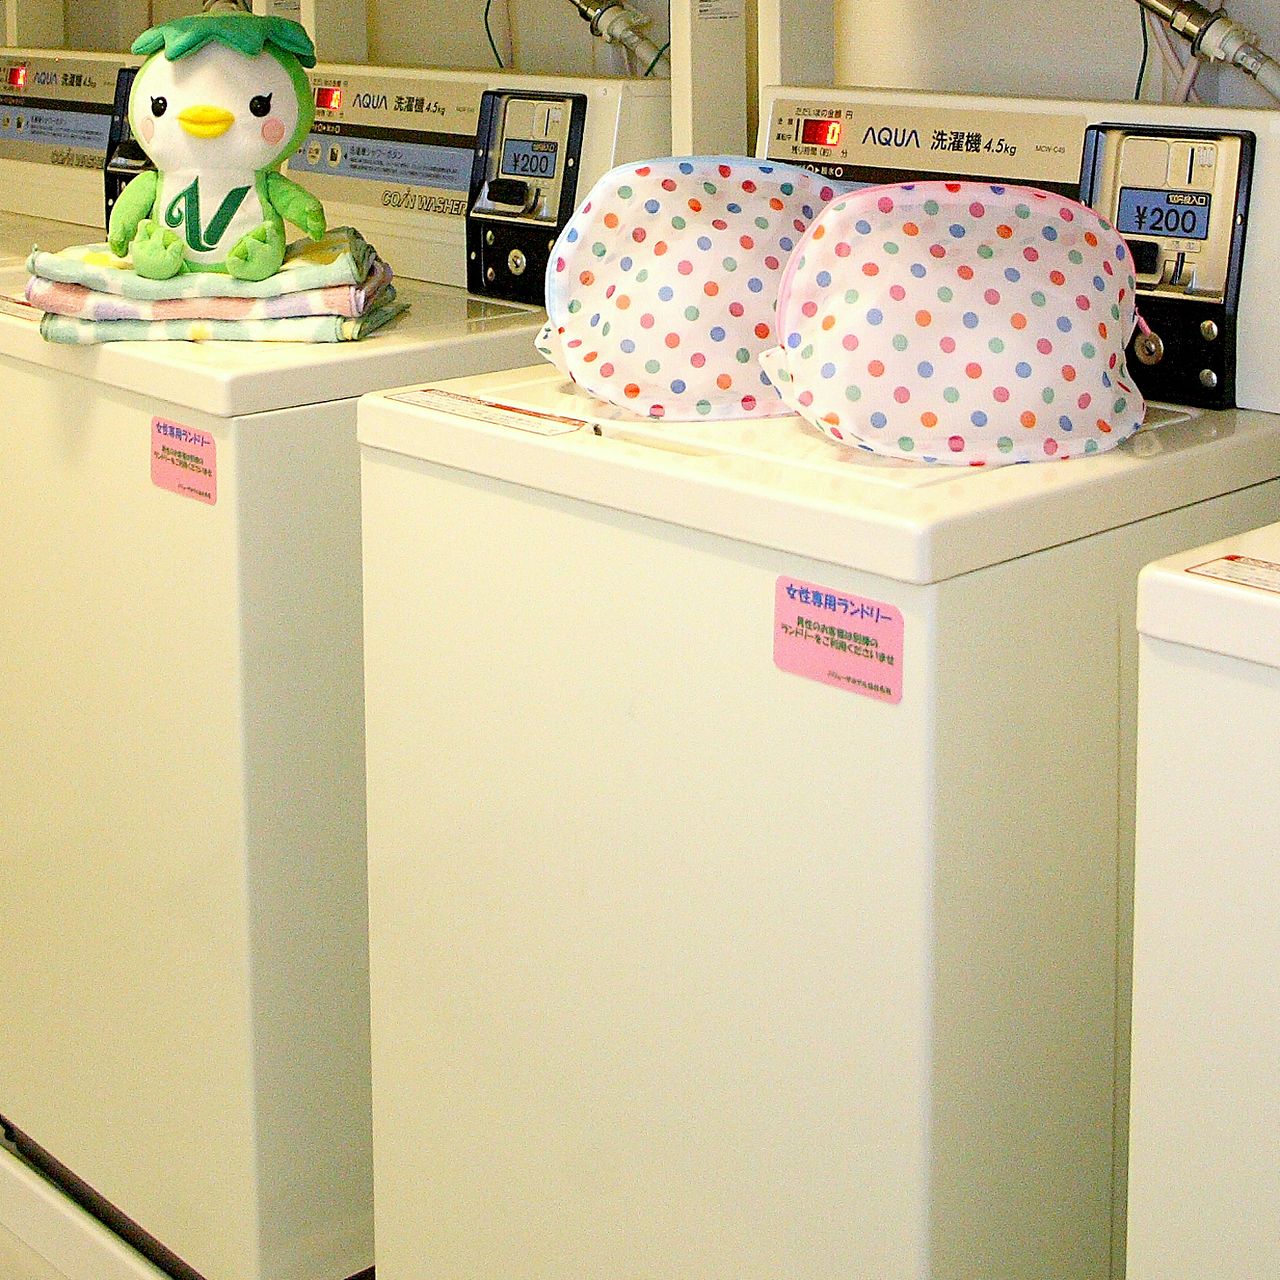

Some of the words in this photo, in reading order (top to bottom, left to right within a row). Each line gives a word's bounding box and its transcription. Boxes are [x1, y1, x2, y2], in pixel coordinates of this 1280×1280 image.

[352, 93, 388, 110] AQUA
[845, 110, 853, 119] 円
[826, 122, 841, 145] 0
[862, 126, 920, 148] AQUA
[931, 130, 982, 153] 洗濯機
[984, 138, 1017, 157] 4.5kg
[513, 152, 549, 173] ¥200
[382, 187, 414, 210] COIN
[165, 176, 252, 252] V
[1136, 206, 1197, 234] ¥200
[785, 583, 893, 624] 女性専用ランドリー
